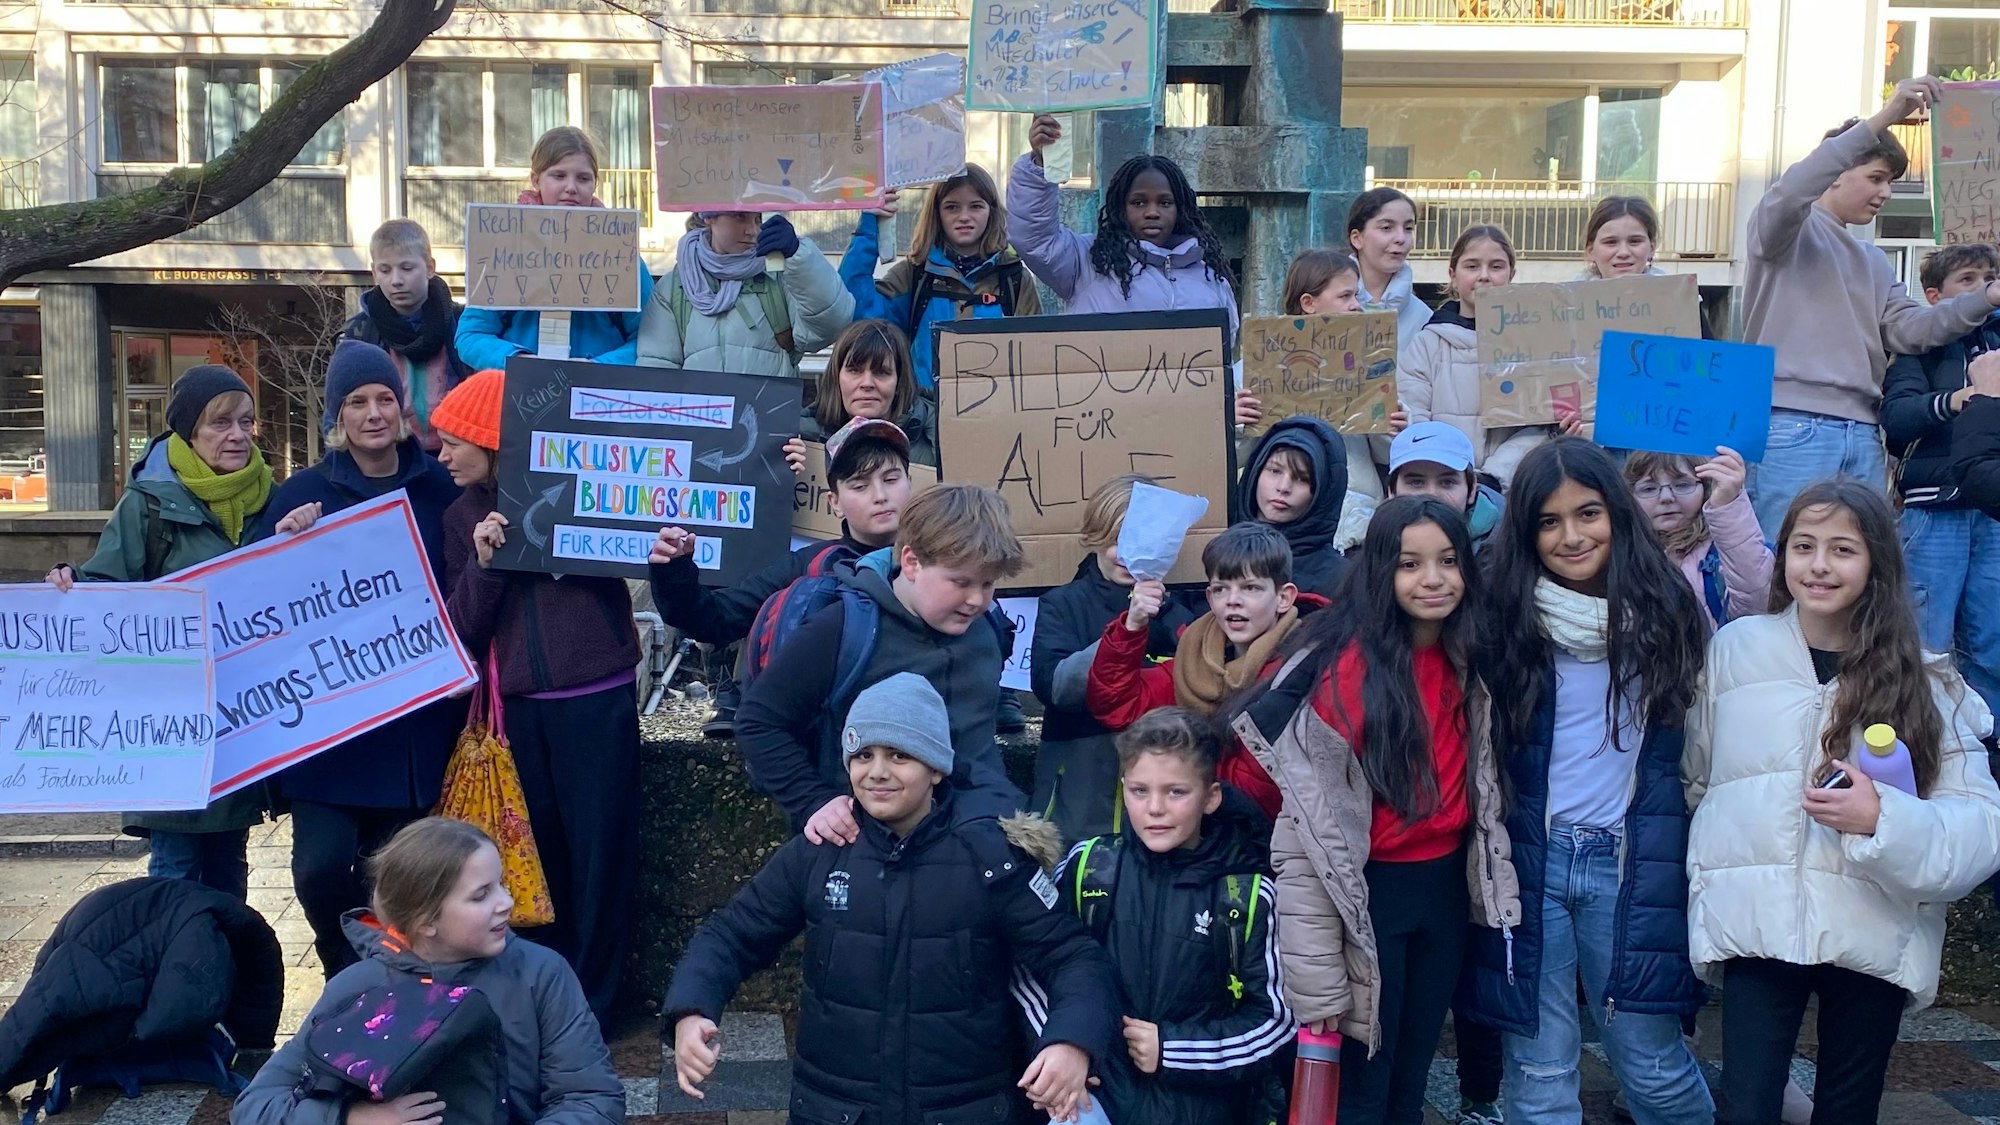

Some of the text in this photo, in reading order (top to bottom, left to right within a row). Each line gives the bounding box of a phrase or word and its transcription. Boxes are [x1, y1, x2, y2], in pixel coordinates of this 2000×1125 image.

[984, 3, 1050, 34] Bringt
[976, 74, 993, 92] in
[673, 92, 801, 122] Bringt unsere
[772, 132, 794, 144] in
[808, 131, 839, 149] die
[478, 208, 637, 246] Recht auf Bildung
[1490, 302, 1541, 335] Jedes
[1595, 297, 1621, 319] hat
[1628, 301, 1651, 318] ein
[1252, 329, 1296, 361] Jedes
[1364, 321, 1395, 348] hat
[954, 339, 1213, 416] BILDUNG
[1250, 366, 1365, 396] ein Recht auf
[1053, 407, 1116, 448] FÜR
[539, 437, 683, 478] INKLUSIVER
[997, 432, 1177, 517] ALLE
[581, 480, 750, 524] BILDUNGSCAMPUS
[560, 530, 595, 555] FÜR
[288, 580, 336, 627] mit
[336, 568, 402, 609] dem
[0, 612, 206, 656] USIVE SCHULE
[17, 668, 45, 705] für
[46, 668, 106, 699] Eltern
[15, 711, 100, 750] MEHR
[101, 709, 214, 751] AUFWAND
[0, 763, 26, 788] als
